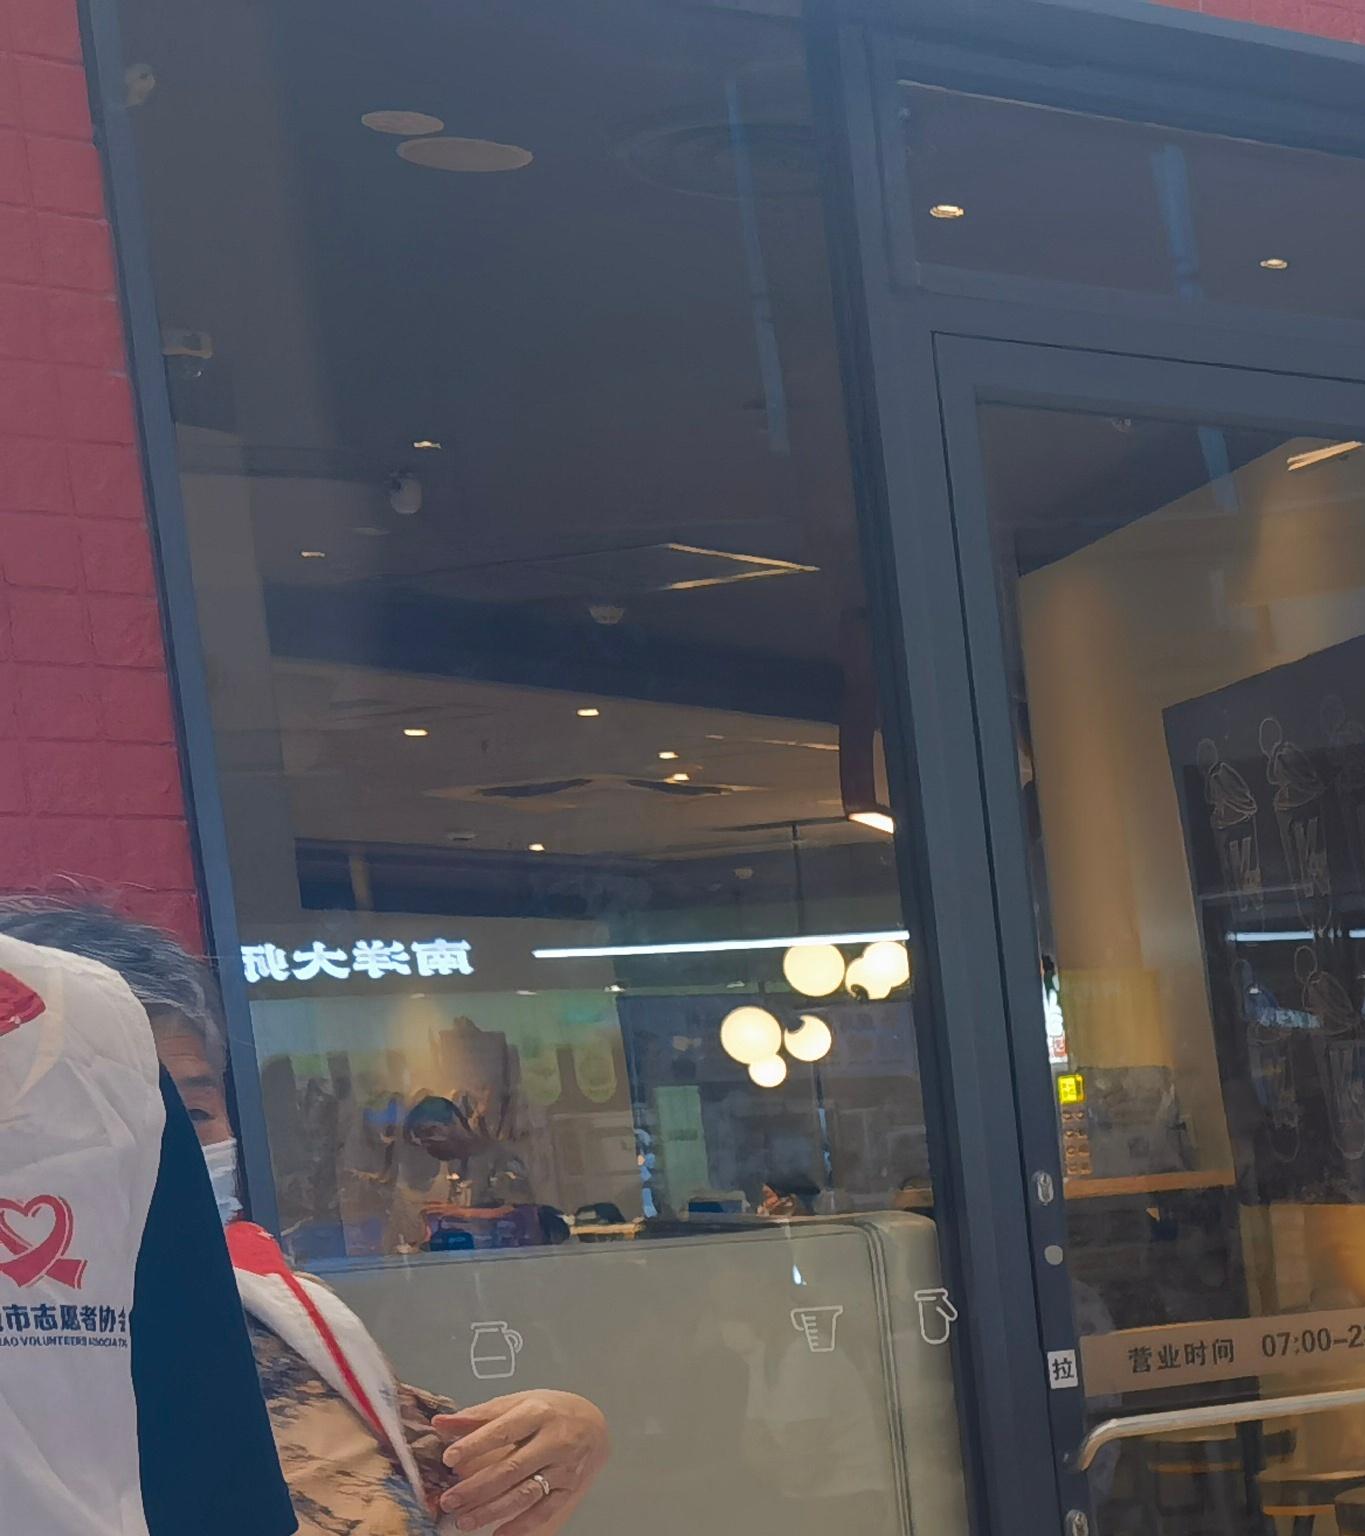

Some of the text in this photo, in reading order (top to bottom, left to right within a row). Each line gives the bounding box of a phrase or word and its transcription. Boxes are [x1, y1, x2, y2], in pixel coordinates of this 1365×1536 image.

[1051, 1357, 1075, 1381] 拉
[1128, 1338, 1235, 1375] 营业时间
